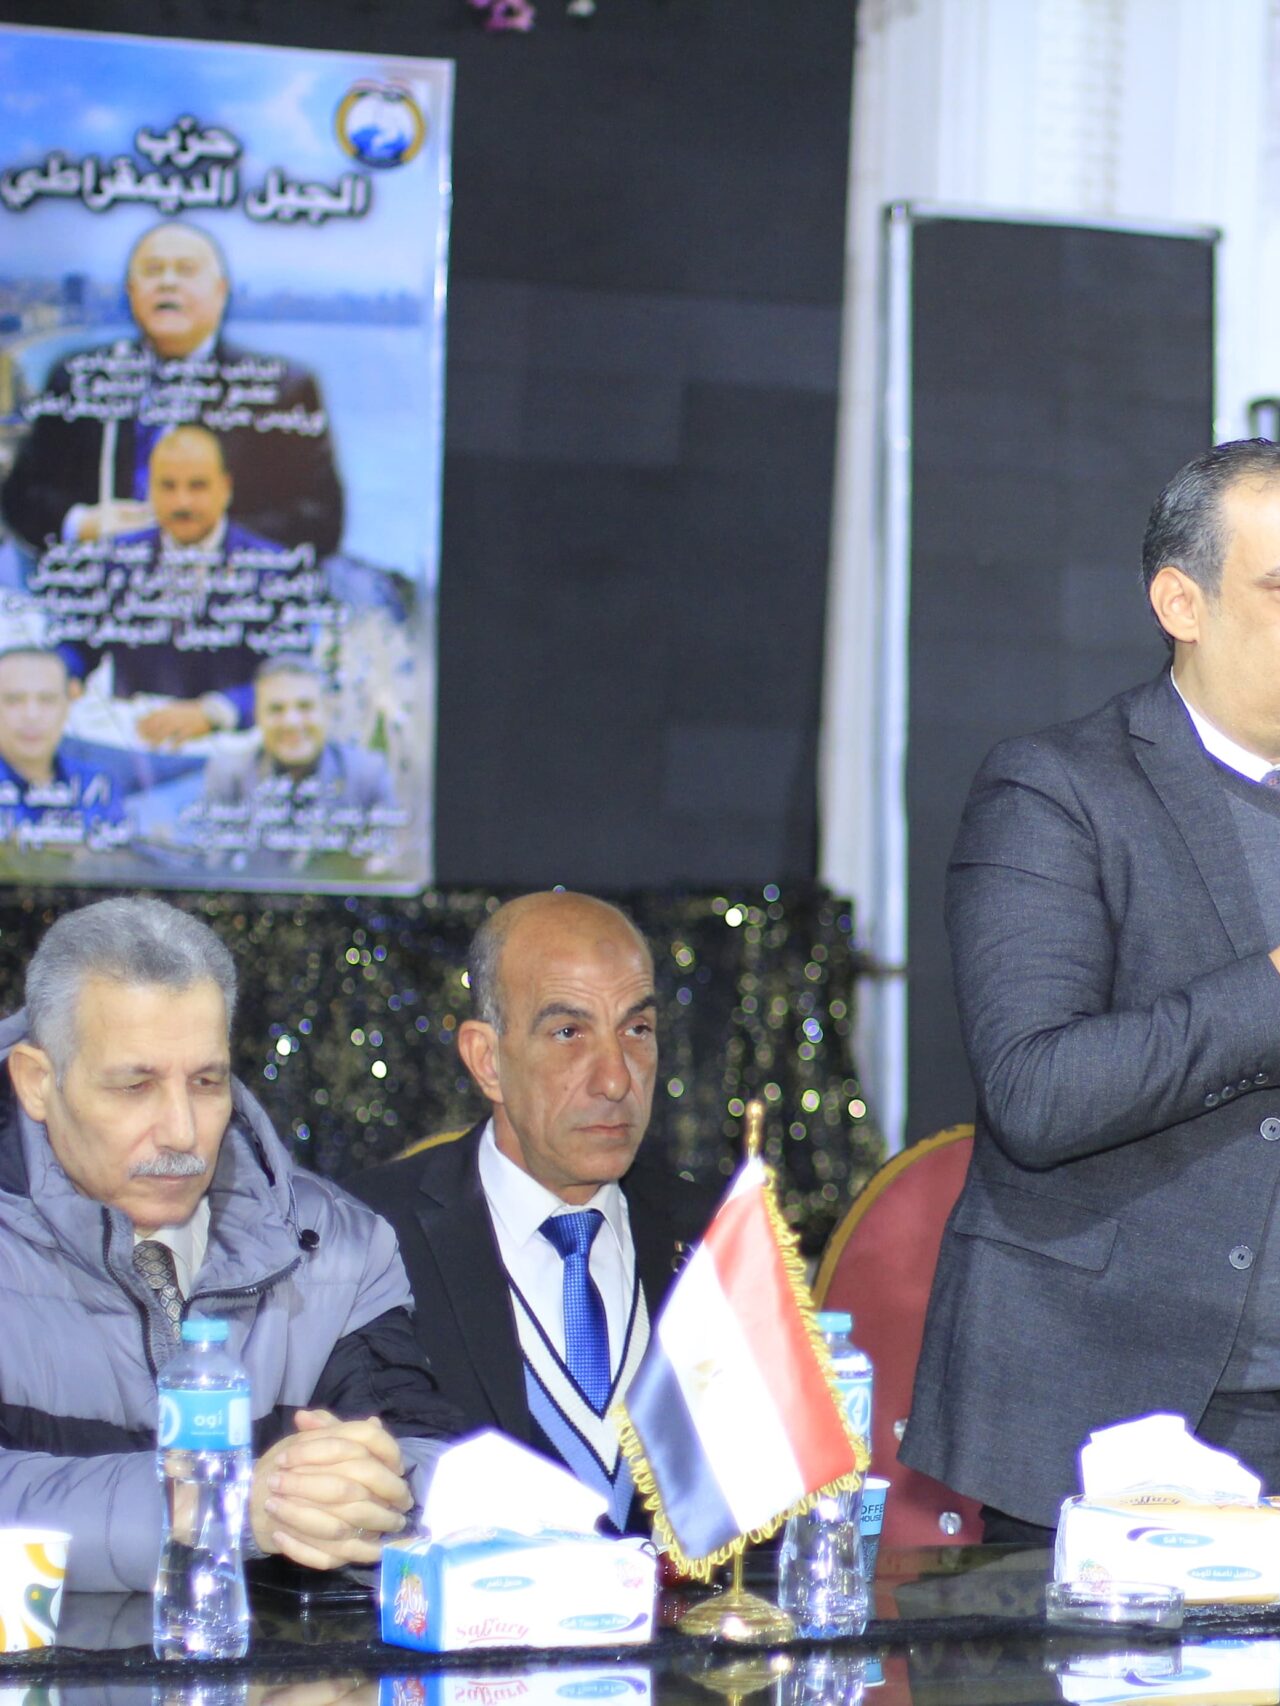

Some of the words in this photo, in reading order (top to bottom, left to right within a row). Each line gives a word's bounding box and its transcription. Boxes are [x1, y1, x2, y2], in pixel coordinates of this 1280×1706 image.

[137, 115, 240, 168] حزب
[246, 168, 370, 221] الجيل
[226, 382, 279, 409] عضو
[202, 405, 253, 431] حزب
[173, 622, 243, 652] الجيل
